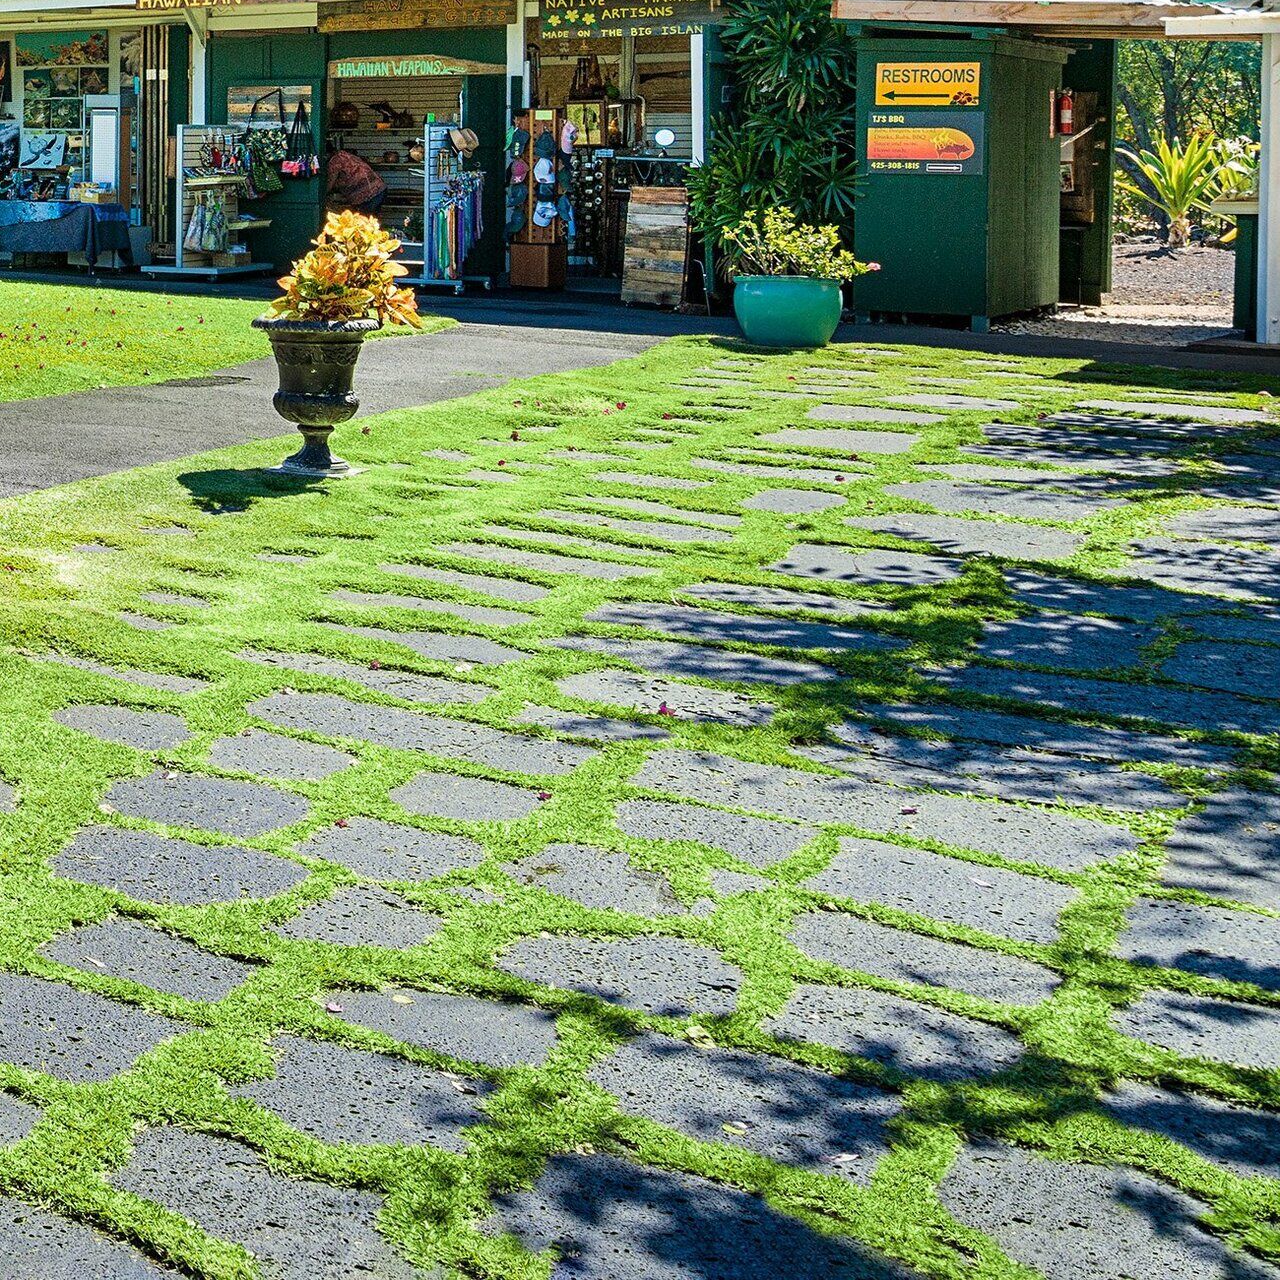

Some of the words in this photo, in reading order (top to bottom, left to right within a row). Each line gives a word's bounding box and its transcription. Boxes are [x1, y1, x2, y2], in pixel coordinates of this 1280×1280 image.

[601, 6, 674, 20] ARTISANS
[542, 29, 569, 39] MADE
[577, 29, 590, 38] ON
[601, 29, 622, 37] THE
[630, 27, 652, 37] BIG
[661, 25, 704, 35] ISLAN
[337, 61, 389, 77] HAWAIIAN
[391, 60, 442, 76] WEAPONS
[881, 68, 975, 84] RESTROOMS
[872, 115, 887, 123] TJ'S
[888, 115, 904, 124] BBQ
[871, 162, 919, 170] 425-308-1815
